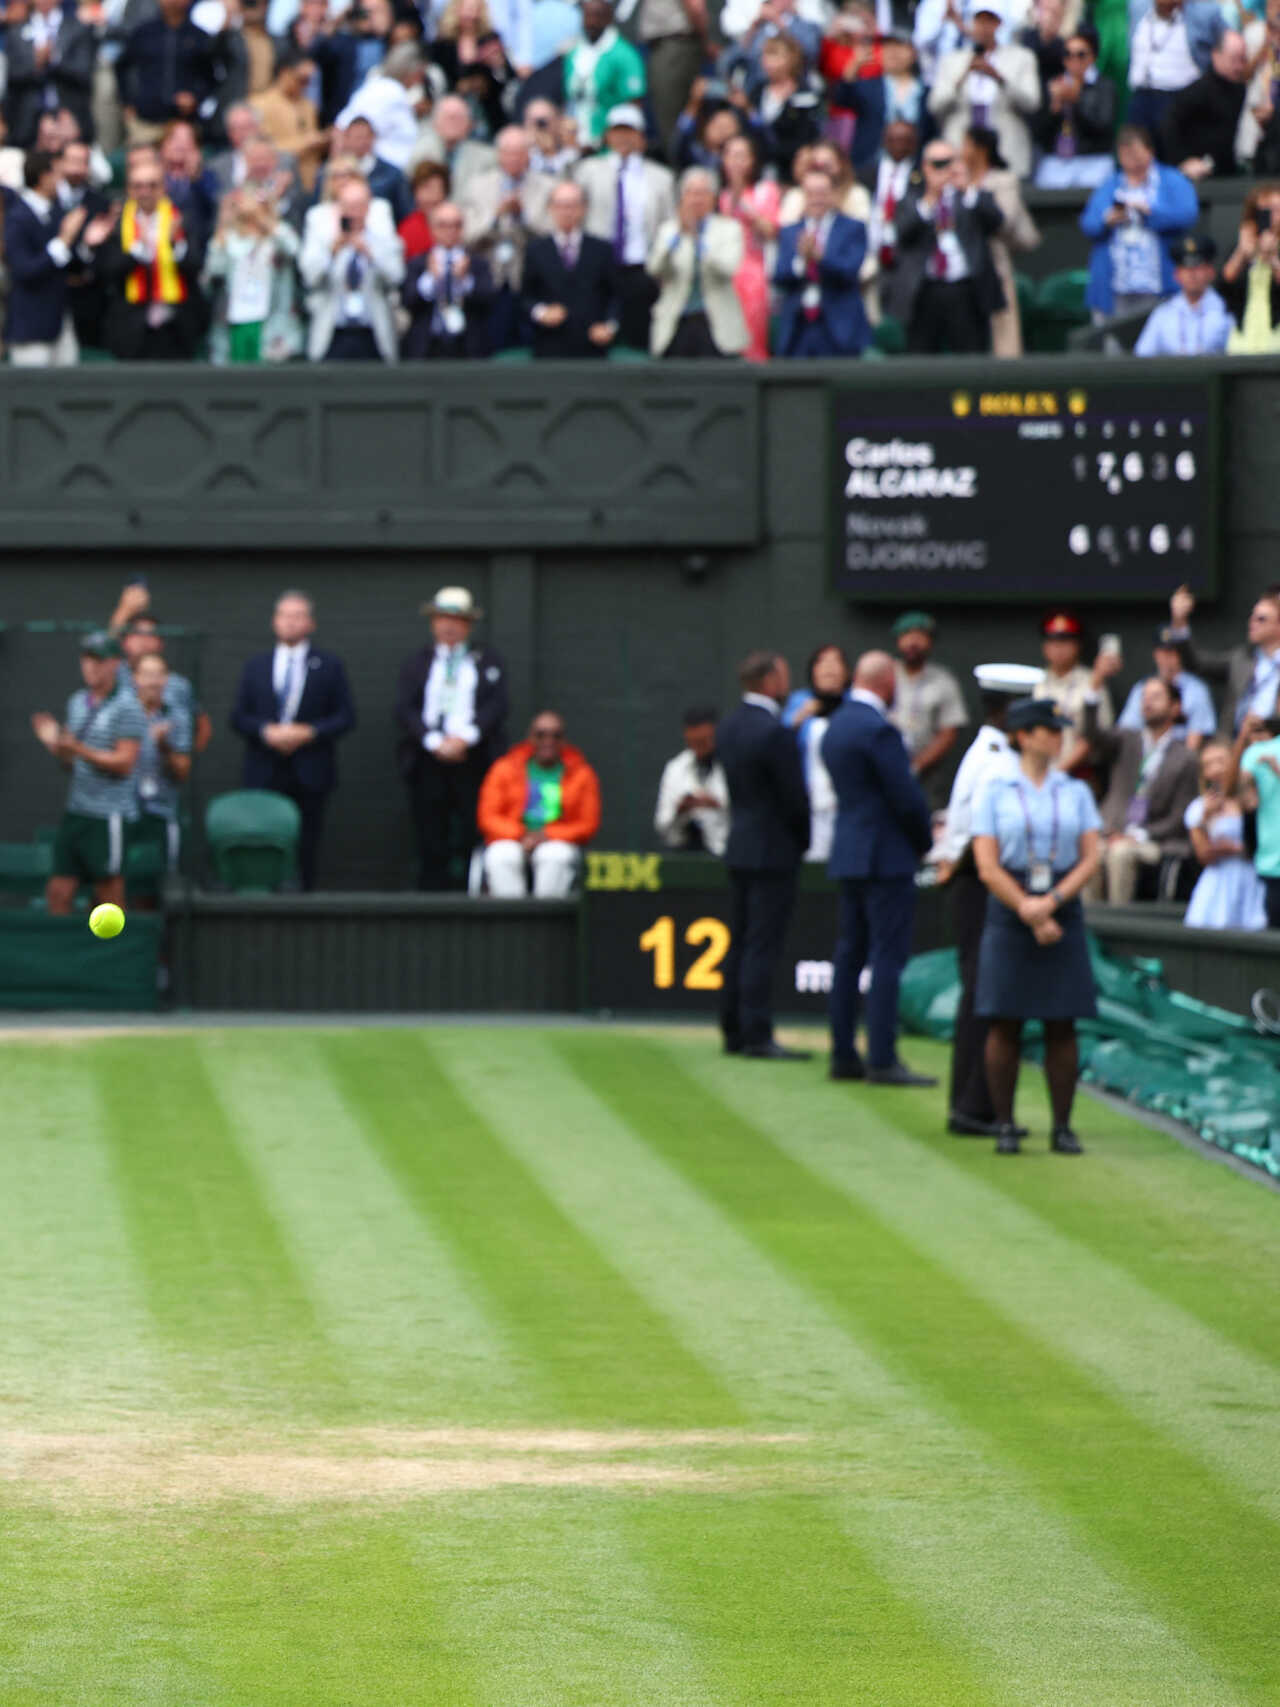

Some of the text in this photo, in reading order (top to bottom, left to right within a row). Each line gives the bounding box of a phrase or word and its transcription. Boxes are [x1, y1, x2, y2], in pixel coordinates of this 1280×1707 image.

[979, 391, 1059, 417] ROLEX
[845, 438, 934, 468] Carlos
[845, 467, 978, 498] ALCARAZ
[846, 541, 987, 570] DJOKOVIC
[585, 853, 661, 891] IBM
[639, 915, 731, 990] 12
